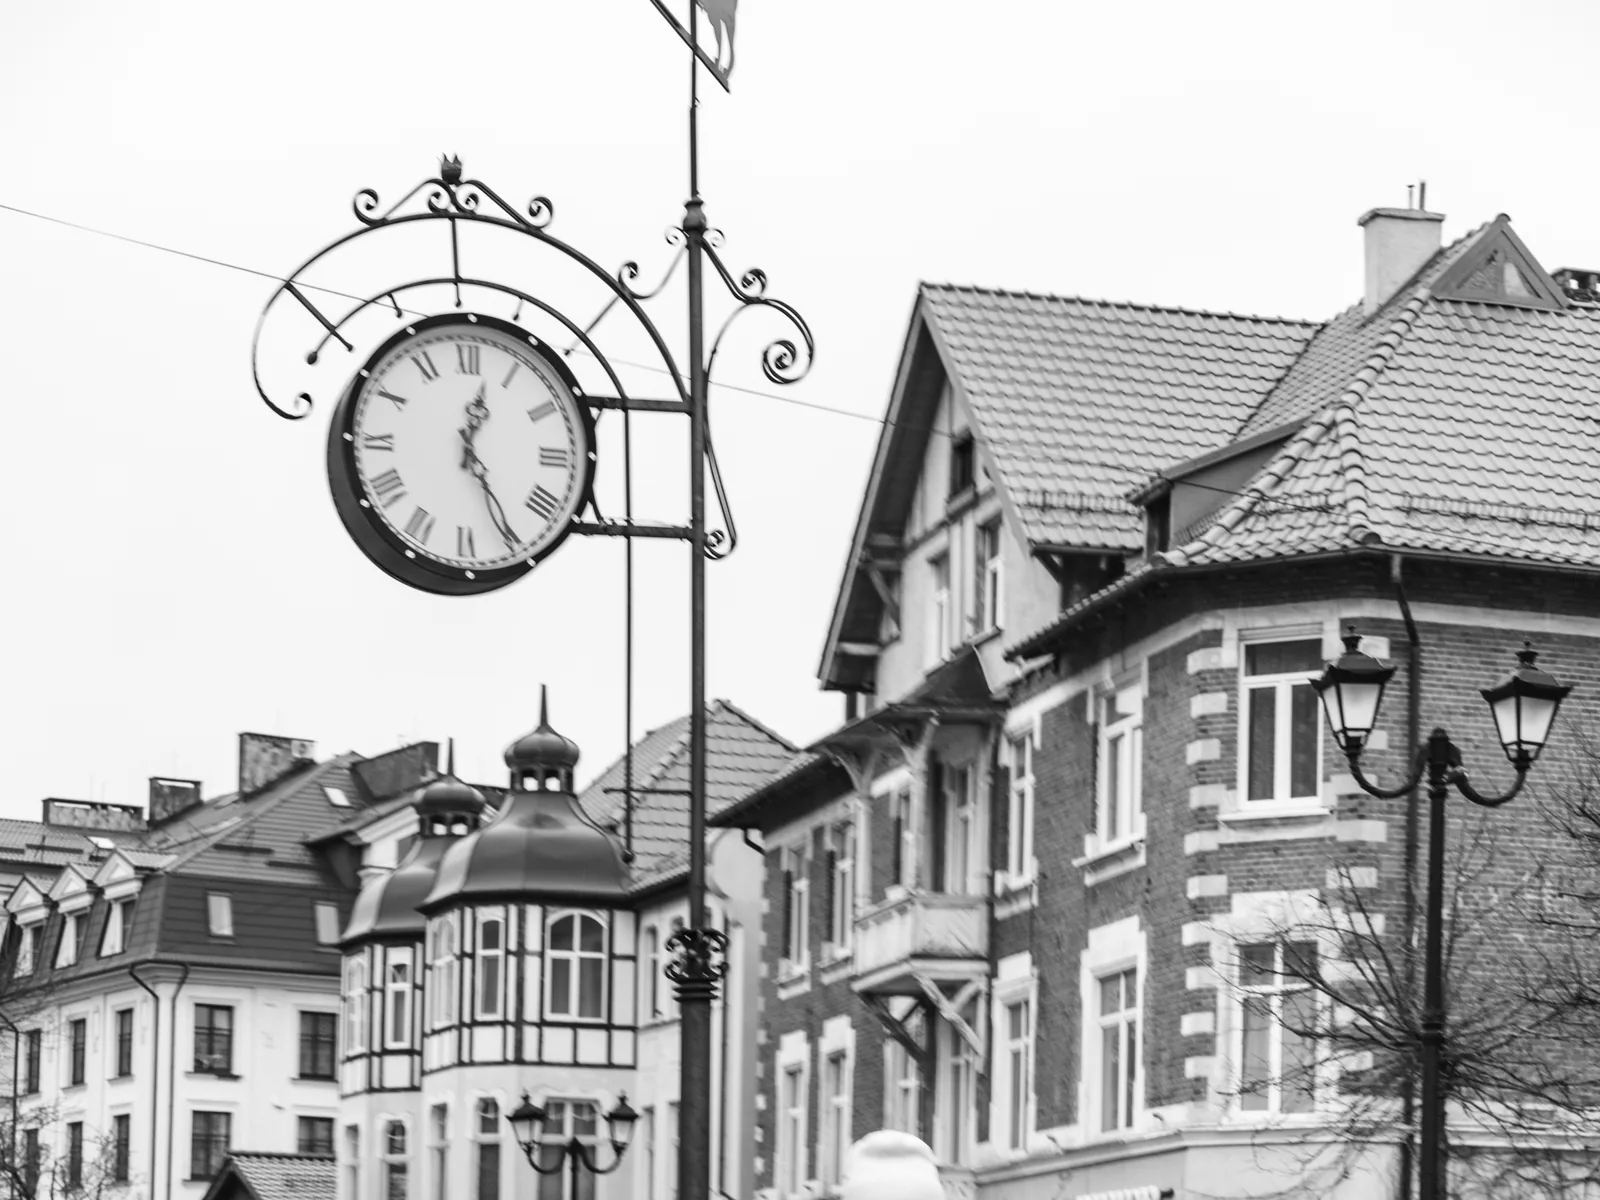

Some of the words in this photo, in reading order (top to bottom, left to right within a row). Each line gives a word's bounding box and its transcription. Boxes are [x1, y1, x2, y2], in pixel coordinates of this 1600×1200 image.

[377, 383, 406, 412] X
[538, 446, 568, 469] III
[524, 483, 564, 522] IIII
